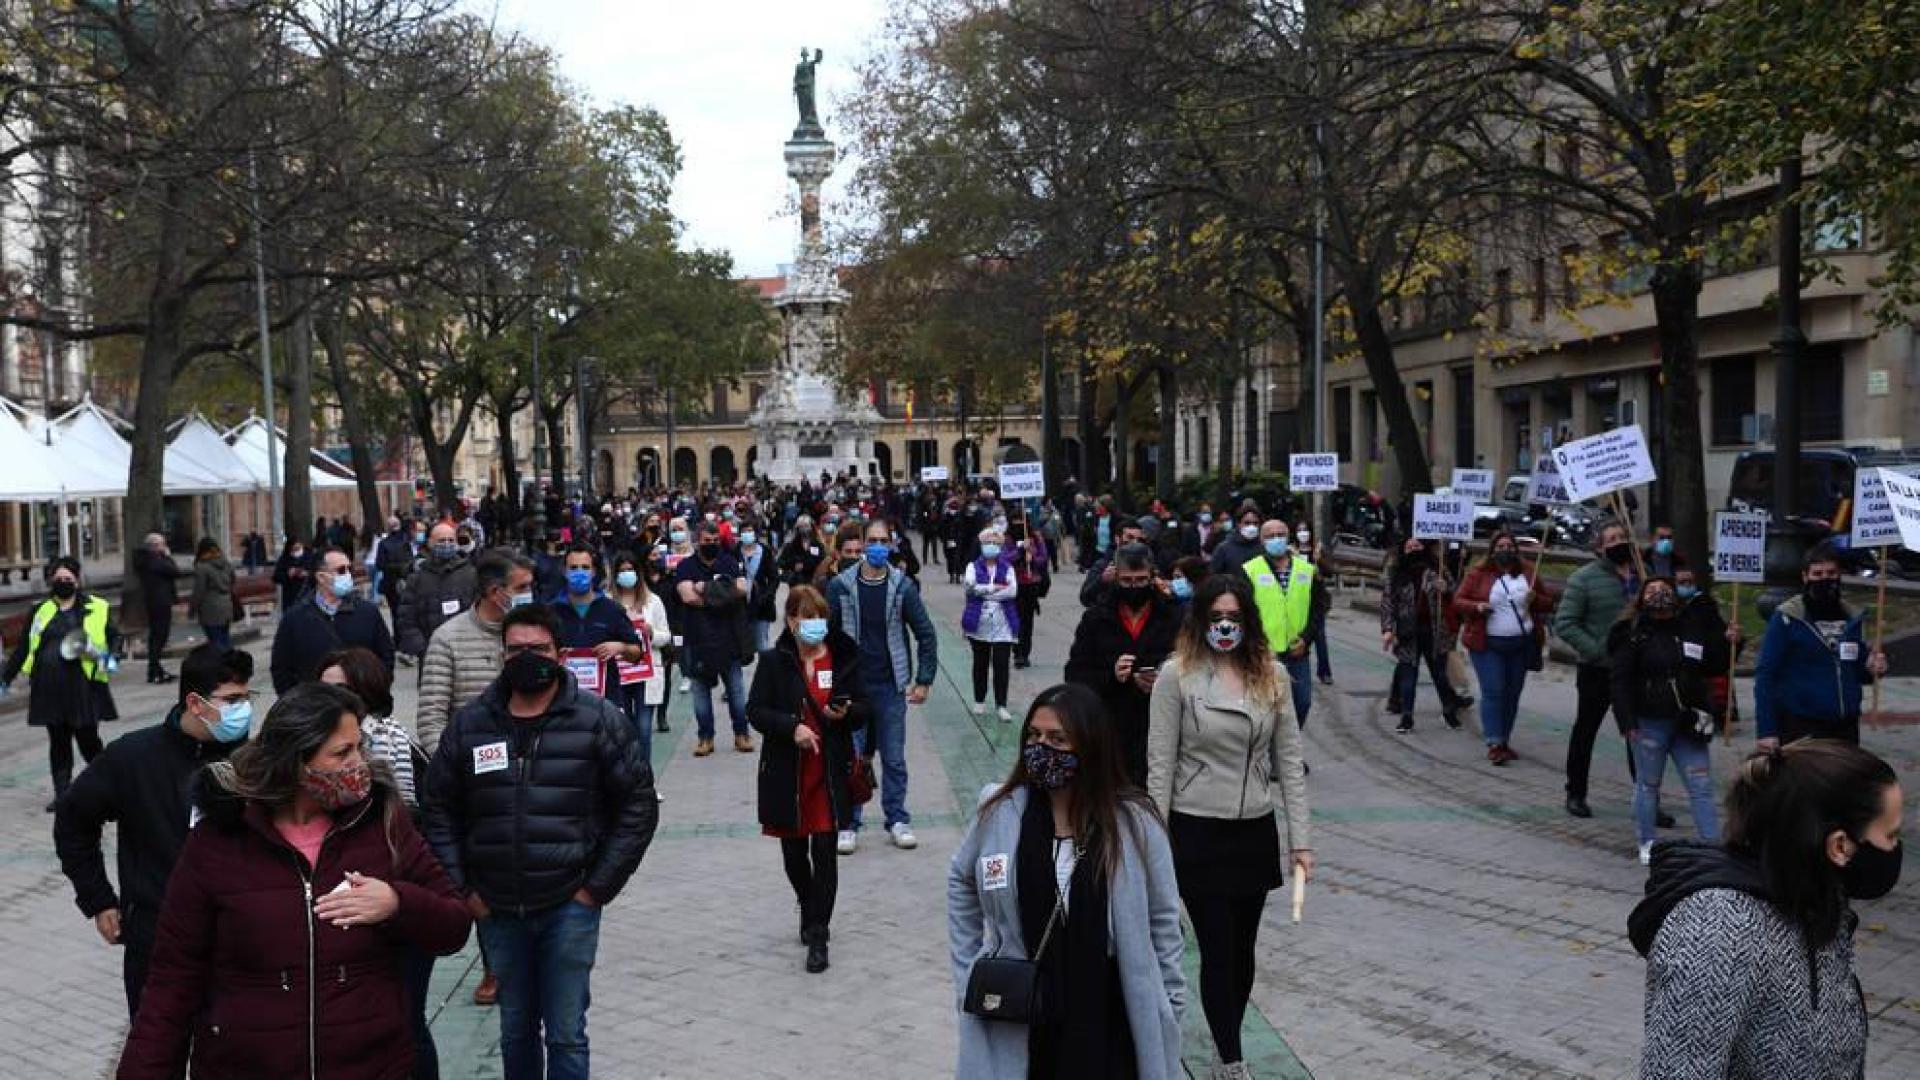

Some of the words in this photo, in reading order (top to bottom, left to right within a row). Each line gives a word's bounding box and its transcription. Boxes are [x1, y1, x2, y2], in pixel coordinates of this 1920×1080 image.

[1295, 456, 1334, 467] APRENDED
[1293, 475, 1302, 485] DE
[1305, 475, 1335, 485] MERKEL
[1427, 501, 1451, 514] BARES
[1458, 522, 1469, 534] NO
[1721, 519, 1762, 538] APRENDED
[1718, 552, 1729, 572] DE
[1730, 553, 1762, 573] MERKEL
[479, 747, 502, 761] SOS
[986, 858, 1004, 872] SOS
